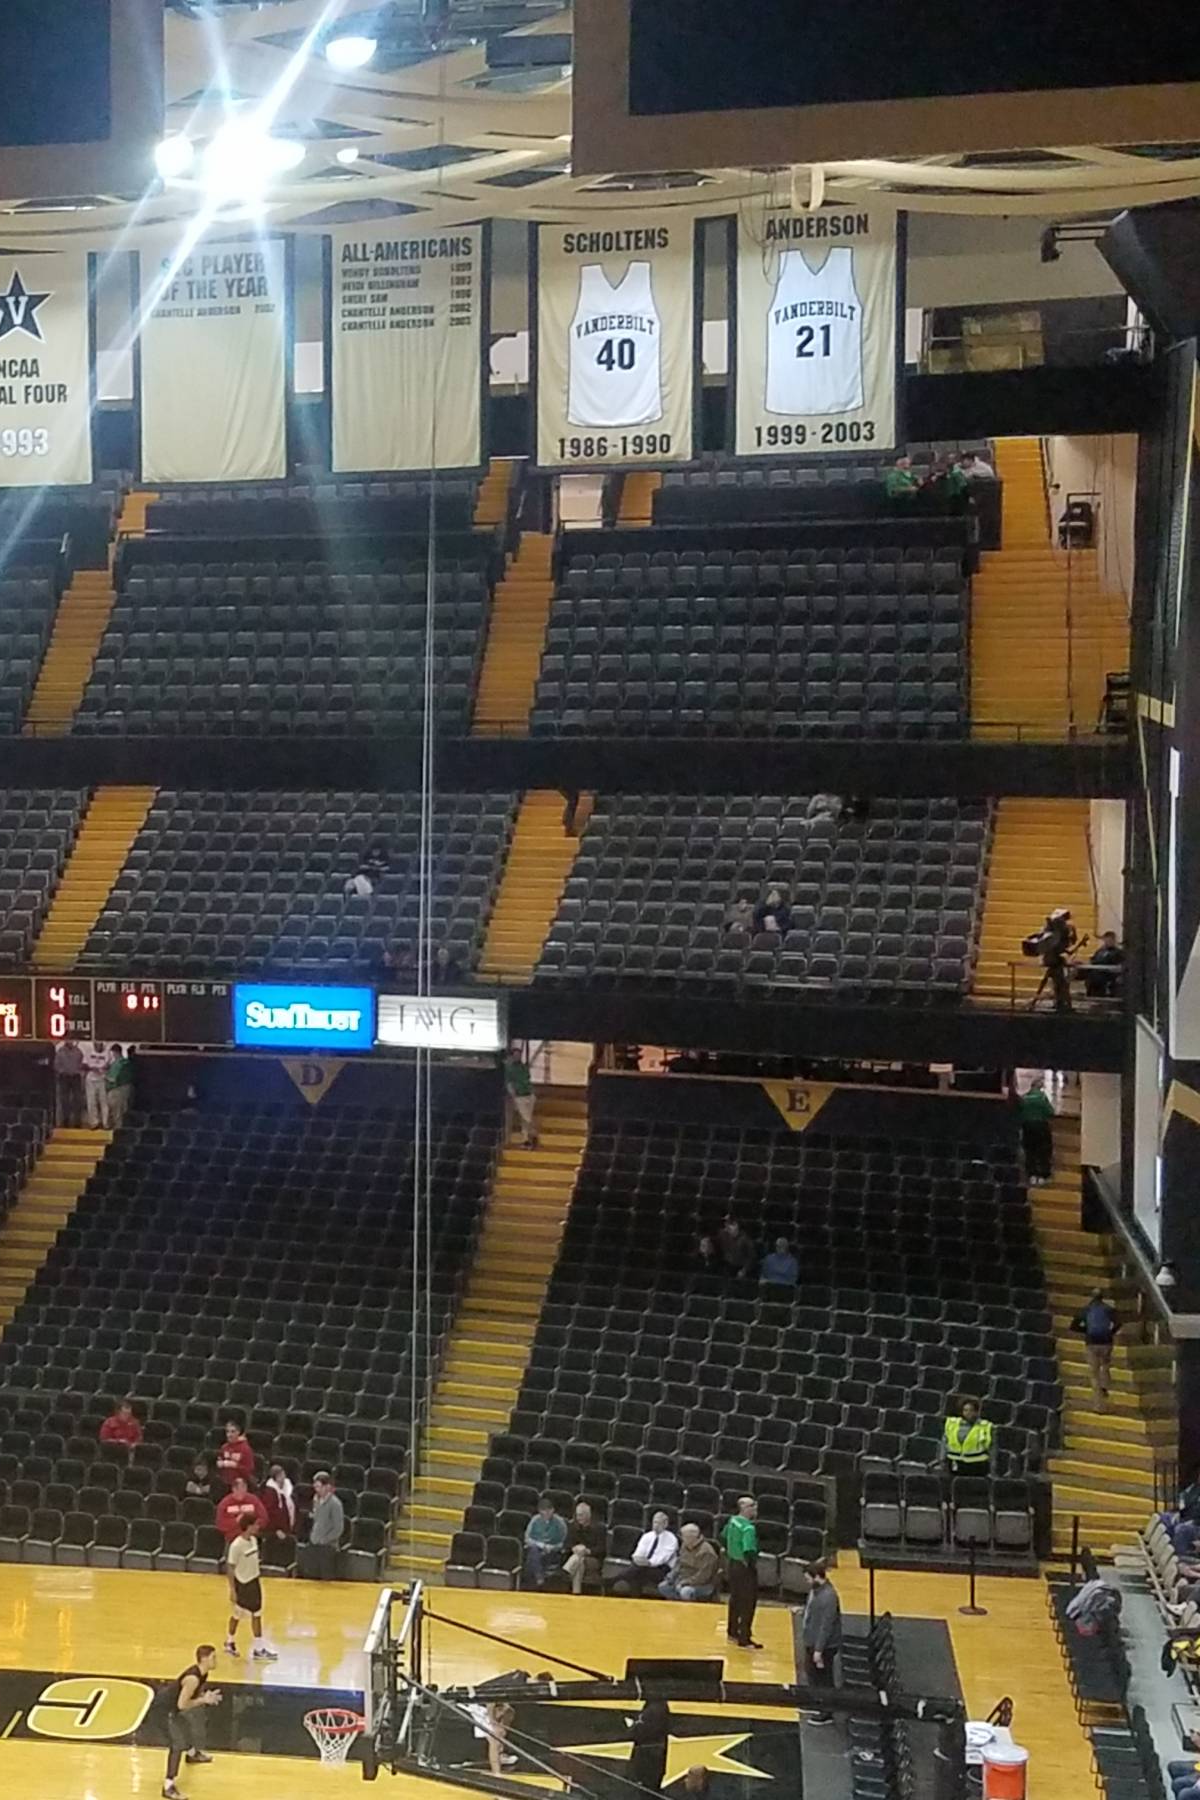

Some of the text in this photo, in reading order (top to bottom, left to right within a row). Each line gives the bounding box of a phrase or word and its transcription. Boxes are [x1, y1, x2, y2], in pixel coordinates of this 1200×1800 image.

[766, 213, 869, 240] ANDERSON
[341, 237, 473, 262] ALL-AMERICANS
[563, 228, 669, 253] SCHOLTENS
[201, 252, 265, 276] PLAYER
[186, 279, 217, 300] THE
[224, 276, 267, 298] YEAR
[6, 296, 29, 325] V
[341, 307, 386, 318] CHANTELLE
[389, 305, 435, 316] ANDERSON
[774, 300, 856, 325] VANDERBILT
[341, 321, 386, 331] CHANTELLE
[389, 318, 435, 330] ANDERSON
[575, 315, 655, 339] VANDERBILT
[795, 324, 833, 358] 21
[596, 338, 636, 372] 40
[23, 384, 68, 404] FOUR
[755, 420, 876, 447] 1999-2003
[558, 434, 672, 459] 1986-1990
[50, 987, 65, 1009] 4
[4, 1015, 19, 1037] 0
[51, 1014, 65, 1037] 0
[301, 1063, 322, 1086] D
[787, 1090, 810, 1113] E
